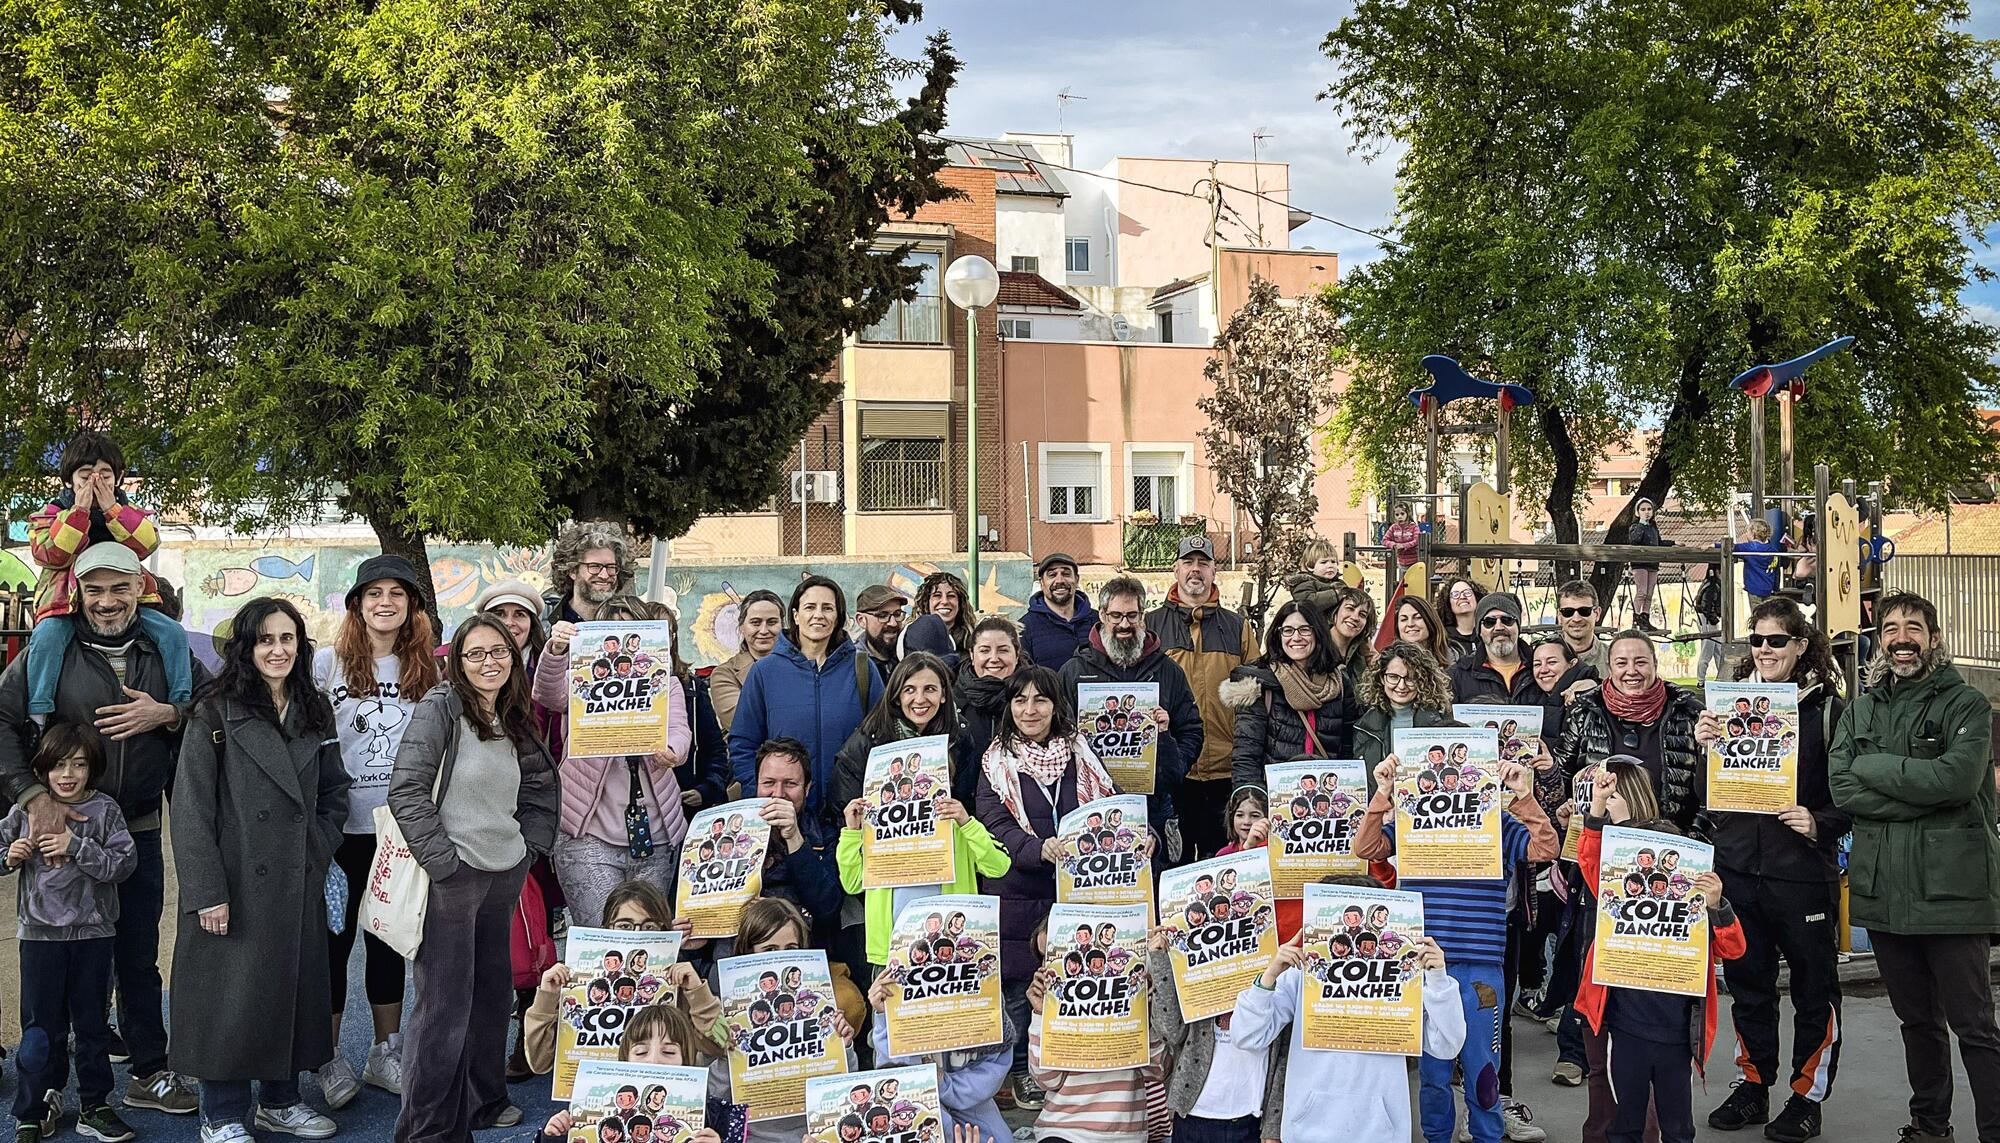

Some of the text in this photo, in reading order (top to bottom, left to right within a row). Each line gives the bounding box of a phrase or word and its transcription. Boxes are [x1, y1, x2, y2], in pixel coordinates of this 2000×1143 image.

[590, 678, 651, 701] COLE
[586, 698, 652, 714] BANCHEL
[1093, 732, 1142, 749] COLE
[1727, 739, 1780, 757] COLE
[1100, 747, 1142, 757] ANCHEL
[1723, 758, 1781, 768] BANCHEL
[360, 773, 378, 782] York
[379, 772, 391, 781] Cit
[877, 800, 933, 826] COLE
[1416, 793, 1481, 816] COLE
[876, 820, 935, 840] BANCHEL
[1288, 819, 1349, 842] COLE
[1413, 814, 1483, 830] BANCHEL
[1285, 839, 1350, 854] BANCHEL
[1076, 853, 1135, 876] COLE
[1074, 872, 1137, 888] BANCHEL
[1620, 900, 1689, 923] COLE
[1806, 913, 1825, 922] PUMA
[1186, 917, 1256, 952] COLE
[1614, 923, 1689, 937] BANCHEL
[1188, 937, 1259, 968] BANCHEL
[906, 963, 979, 986] COLE
[1327, 960, 1402, 984] COLE
[903, 980, 980, 1001] BANCHEL
[1063, 977, 1129, 1002] COLE
[1322, 983, 1402, 998] BANCHEL
[1058, 1001, 1130, 1017] BANCHEL
[749, 1019, 820, 1052] COLE
[748, 1041, 825, 1068] BANCHEL
[152, 1079, 172, 1099] N
